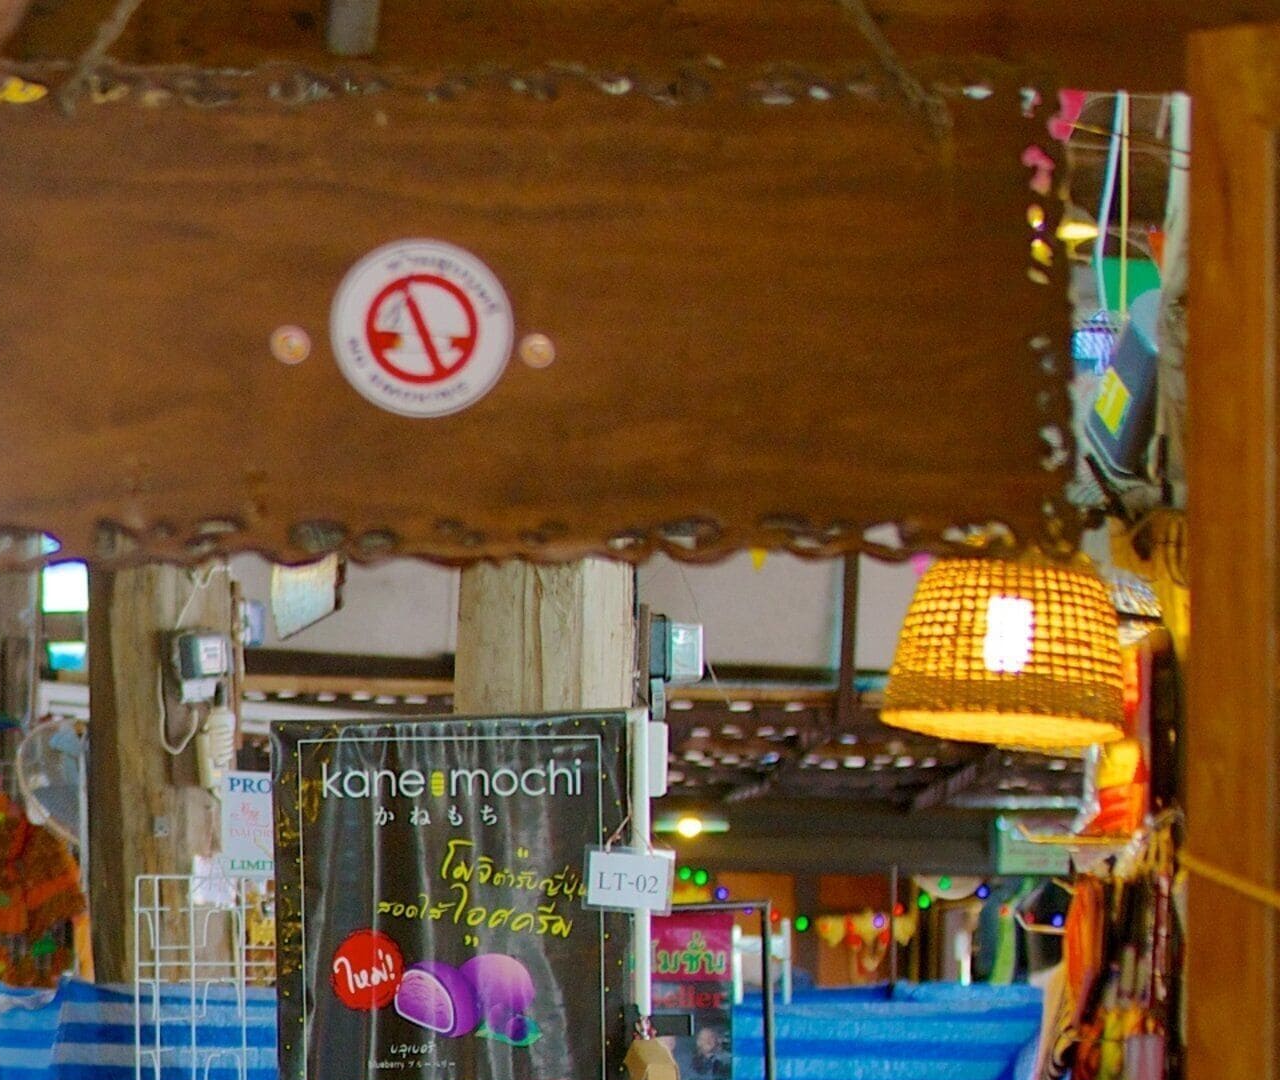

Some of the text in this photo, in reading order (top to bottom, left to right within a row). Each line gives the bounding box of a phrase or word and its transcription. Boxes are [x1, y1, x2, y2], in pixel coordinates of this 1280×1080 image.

[321, 759, 582, 798] kane mochi
[375, 805, 498, 827] かねもち
[599, 871, 658, 895] LT-02
